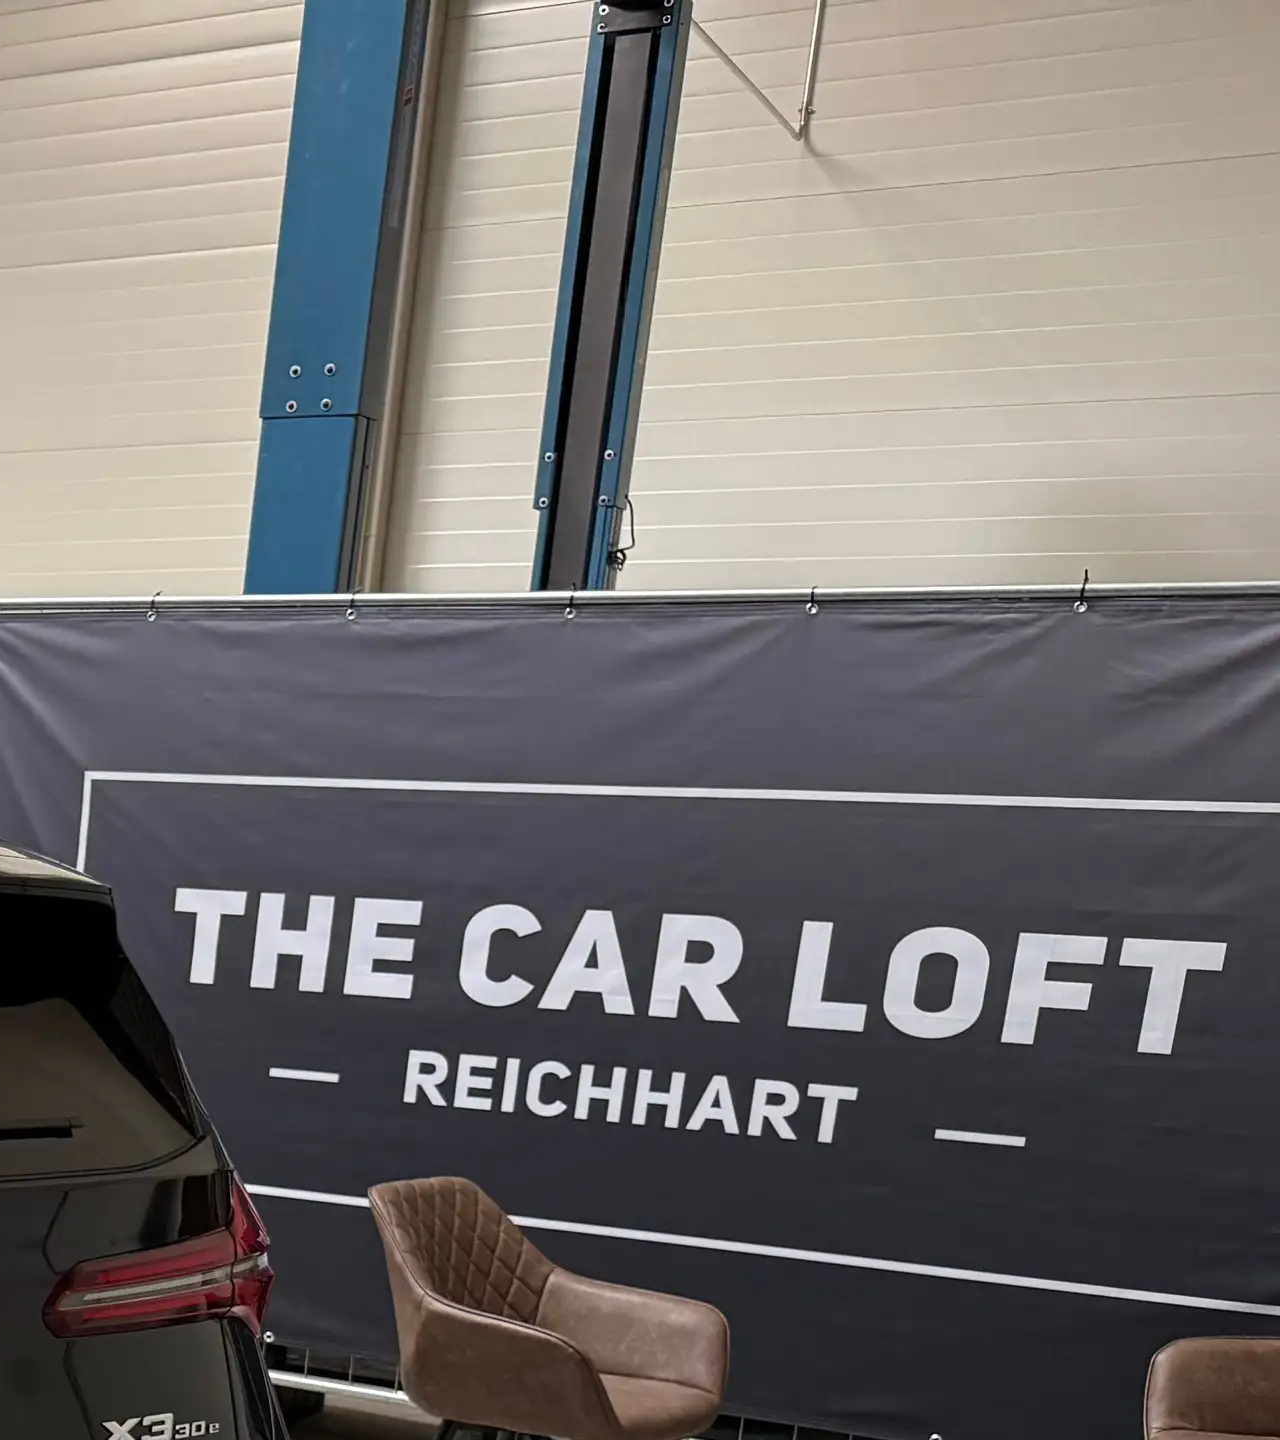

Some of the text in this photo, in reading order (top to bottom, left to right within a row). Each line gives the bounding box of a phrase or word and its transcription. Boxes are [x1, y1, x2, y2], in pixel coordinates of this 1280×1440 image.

[174, 887, 1228, 1055] THE CAR LOFT
[403, 1049, 859, 1144] REICHHART
